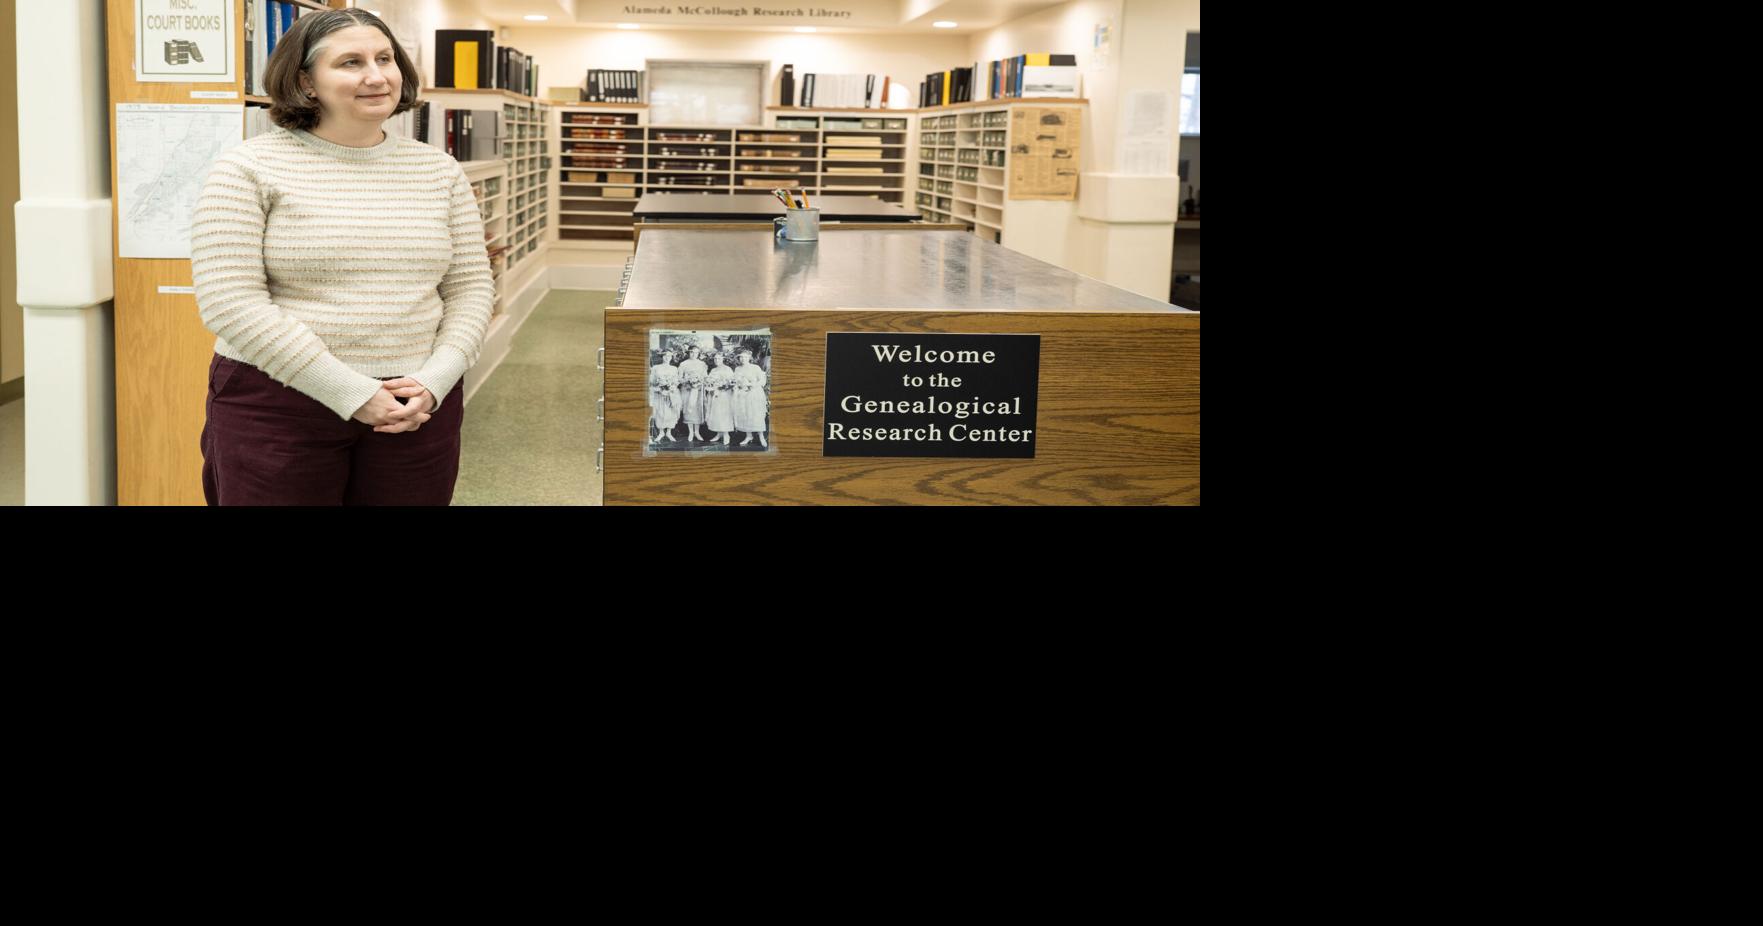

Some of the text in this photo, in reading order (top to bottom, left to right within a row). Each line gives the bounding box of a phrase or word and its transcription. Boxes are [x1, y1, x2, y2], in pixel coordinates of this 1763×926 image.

[169, 0, 198, 10] MISC.
[623, 5, 851, 19] Alameda McCollough Research Library
[146, 15, 221, 30] COURT BOOKS
[871, 344, 996, 364] Welcome
[902, 372, 962, 388] to the
[840, 395, 1021, 419] Genealogical
[827, 422, 1032, 442] Research Center
